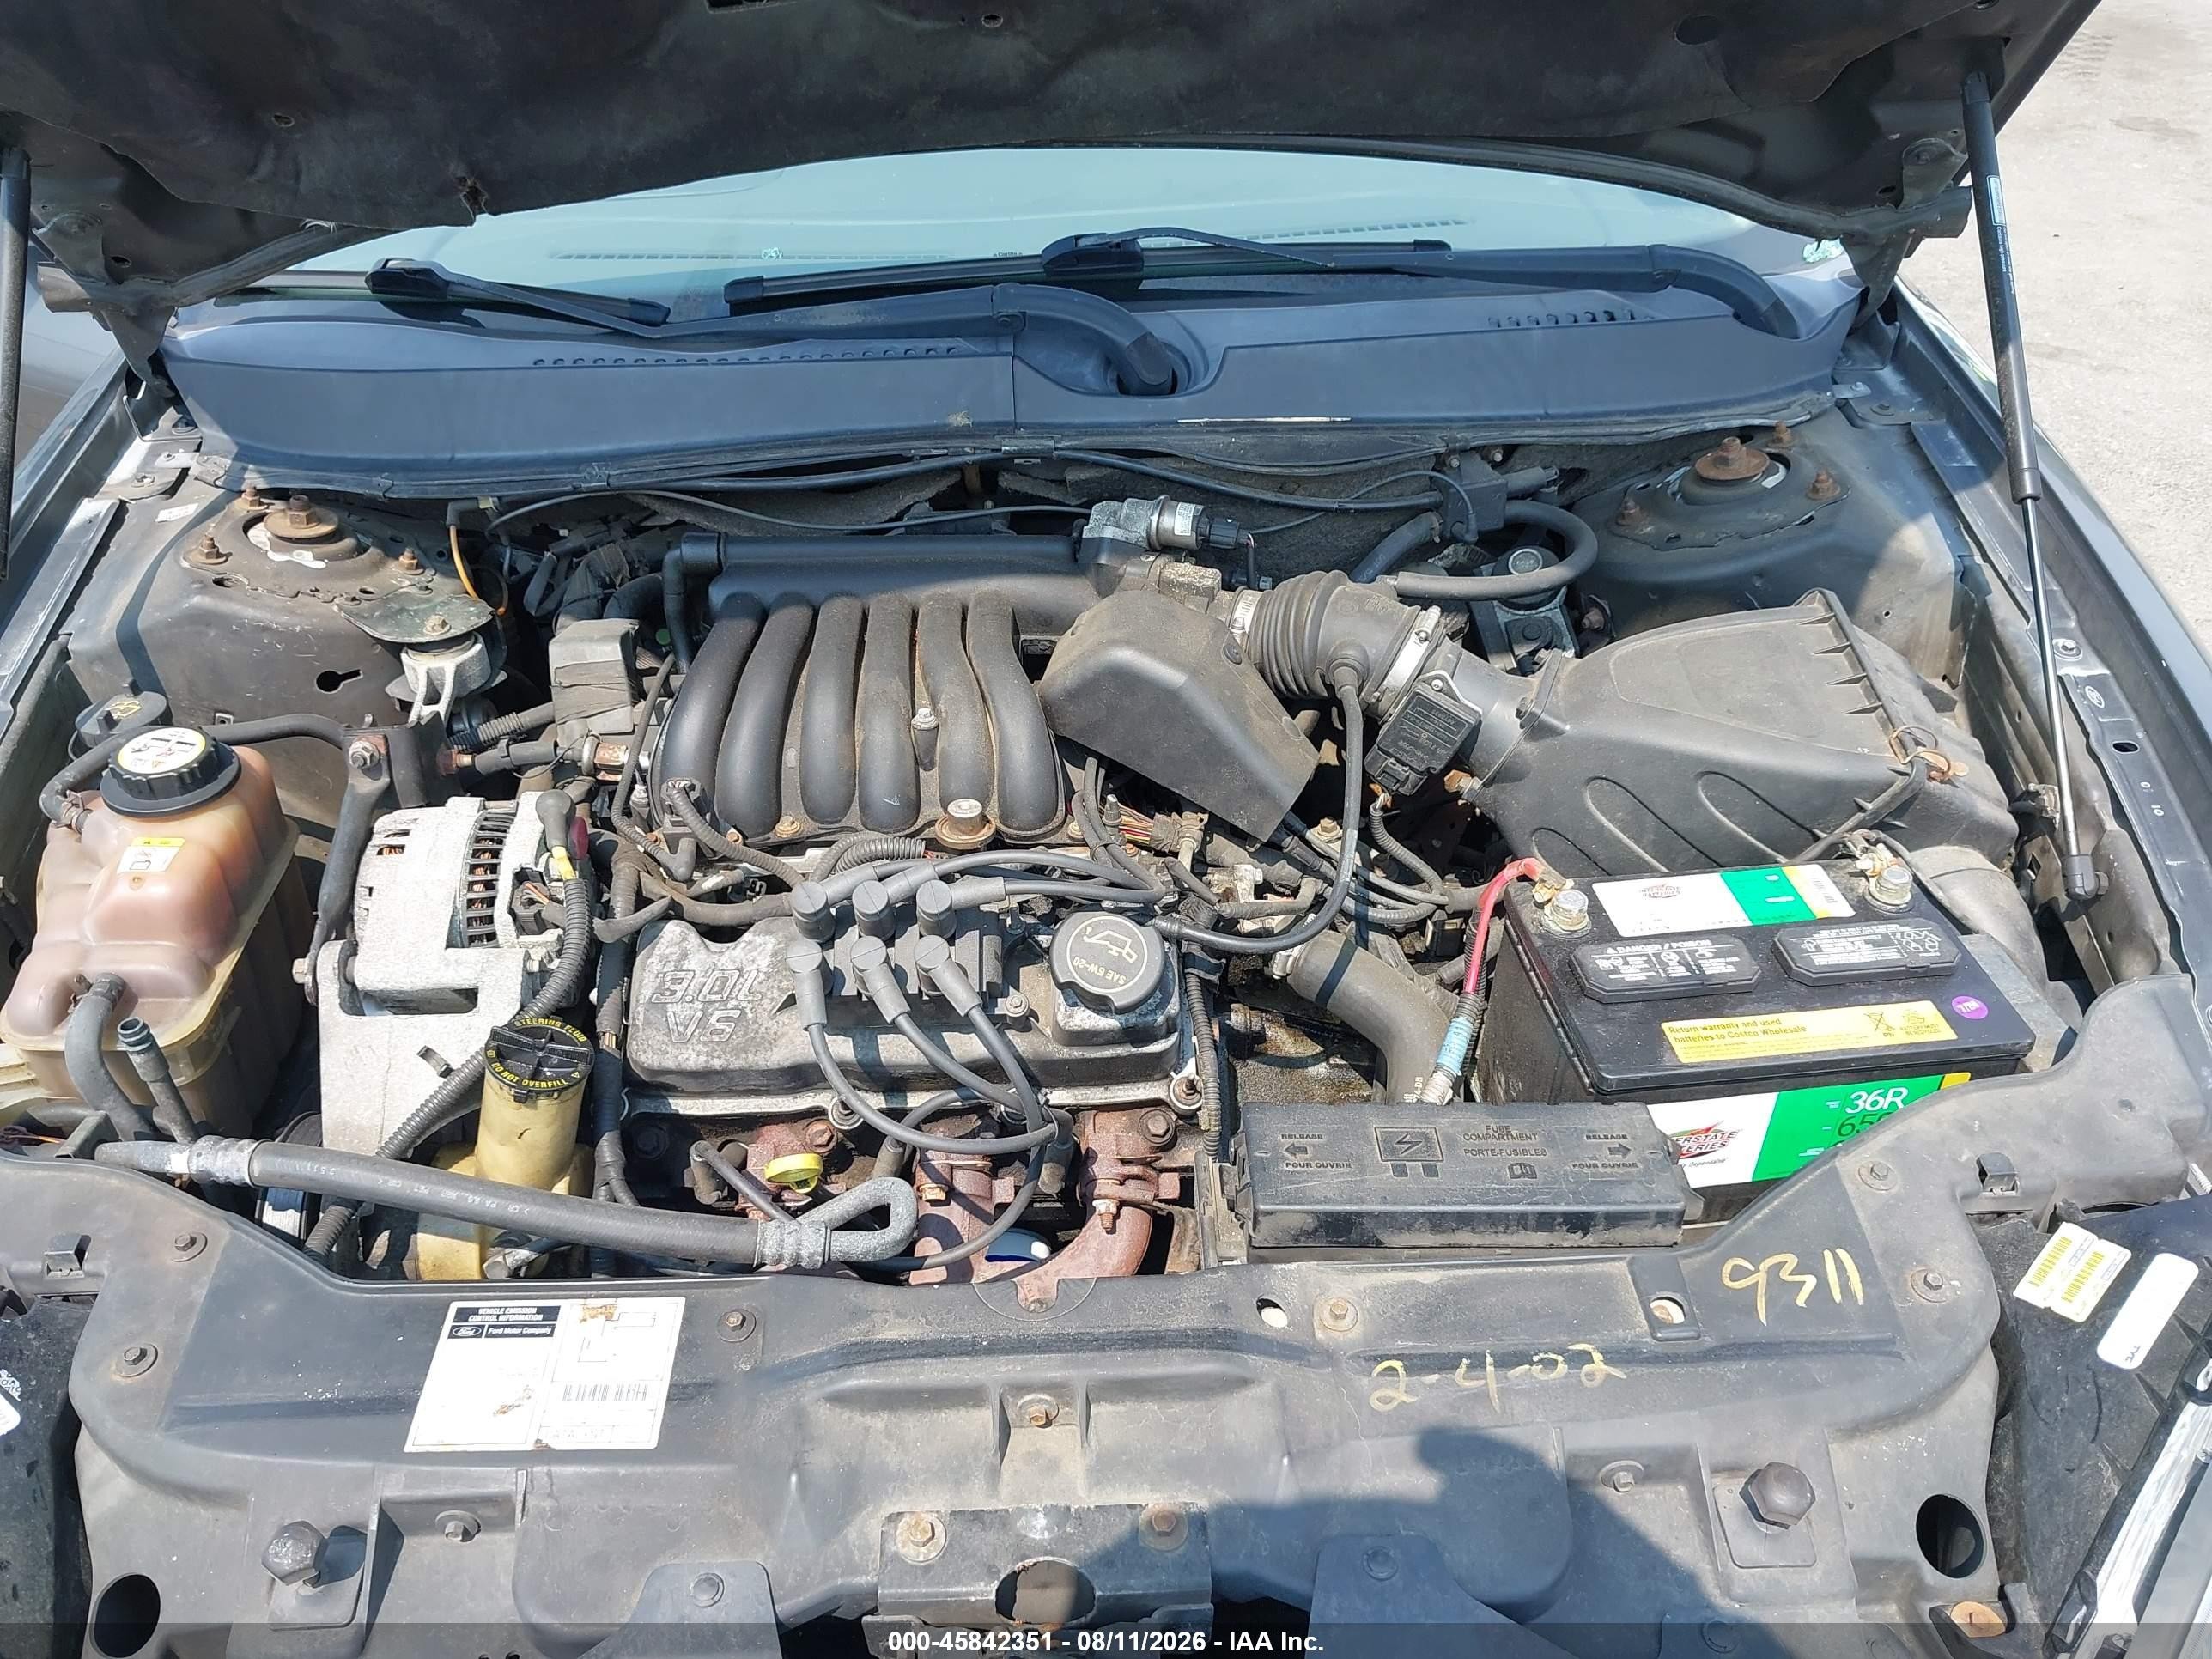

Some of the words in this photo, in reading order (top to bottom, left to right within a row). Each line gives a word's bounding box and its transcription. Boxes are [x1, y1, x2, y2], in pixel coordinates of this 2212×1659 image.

[1616, 945, 1662, 954] DANGER
[1670, 939, 1713, 950] POISON
[1073, 957, 1106, 977] 5W-20
[1105, 969, 1127, 985] SAE
[651, 969, 763, 1003] 3.0L
[515, 1017, 562, 1028] STEERING
[564, 1024, 588, 1042] FLUID
[666, 1009, 742, 1043] V6
[1668, 1026, 1699, 1035] Return
[1702, 1023, 1740, 1033] warranty
[1742, 1020, 1759, 1029] and
[1760, 1018, 1783, 1027] used
[1674, 1033, 1715, 1044] batteries
[1717, 1032, 1727, 1041] to
[1727, 1030, 1759, 1039] Costco
[1761, 1024, 1808, 1037] Wholesale
[491, 1061, 502, 1073] DO
[501, 1068, 520, 1082] NOT
[521, 1078, 568, 1089] OVERFILL
[1845, 1086, 1909, 1115] 36R
[1486, 1125, 1511, 1133] FUSE
[1837, 1112, 1893, 1138] 65
[1462, 1133, 1538, 1142] COMPARTMENT
[1463, 1148, 1548, 1158] PORTE-FUSIBLES
[1722, 1248, 1864, 1327] 9311
[506, 1306, 537, 1315] EMISSION
[522, 1327, 551, 1335] Company
[1370, 1343, 1627, 1413] 2-4-02
